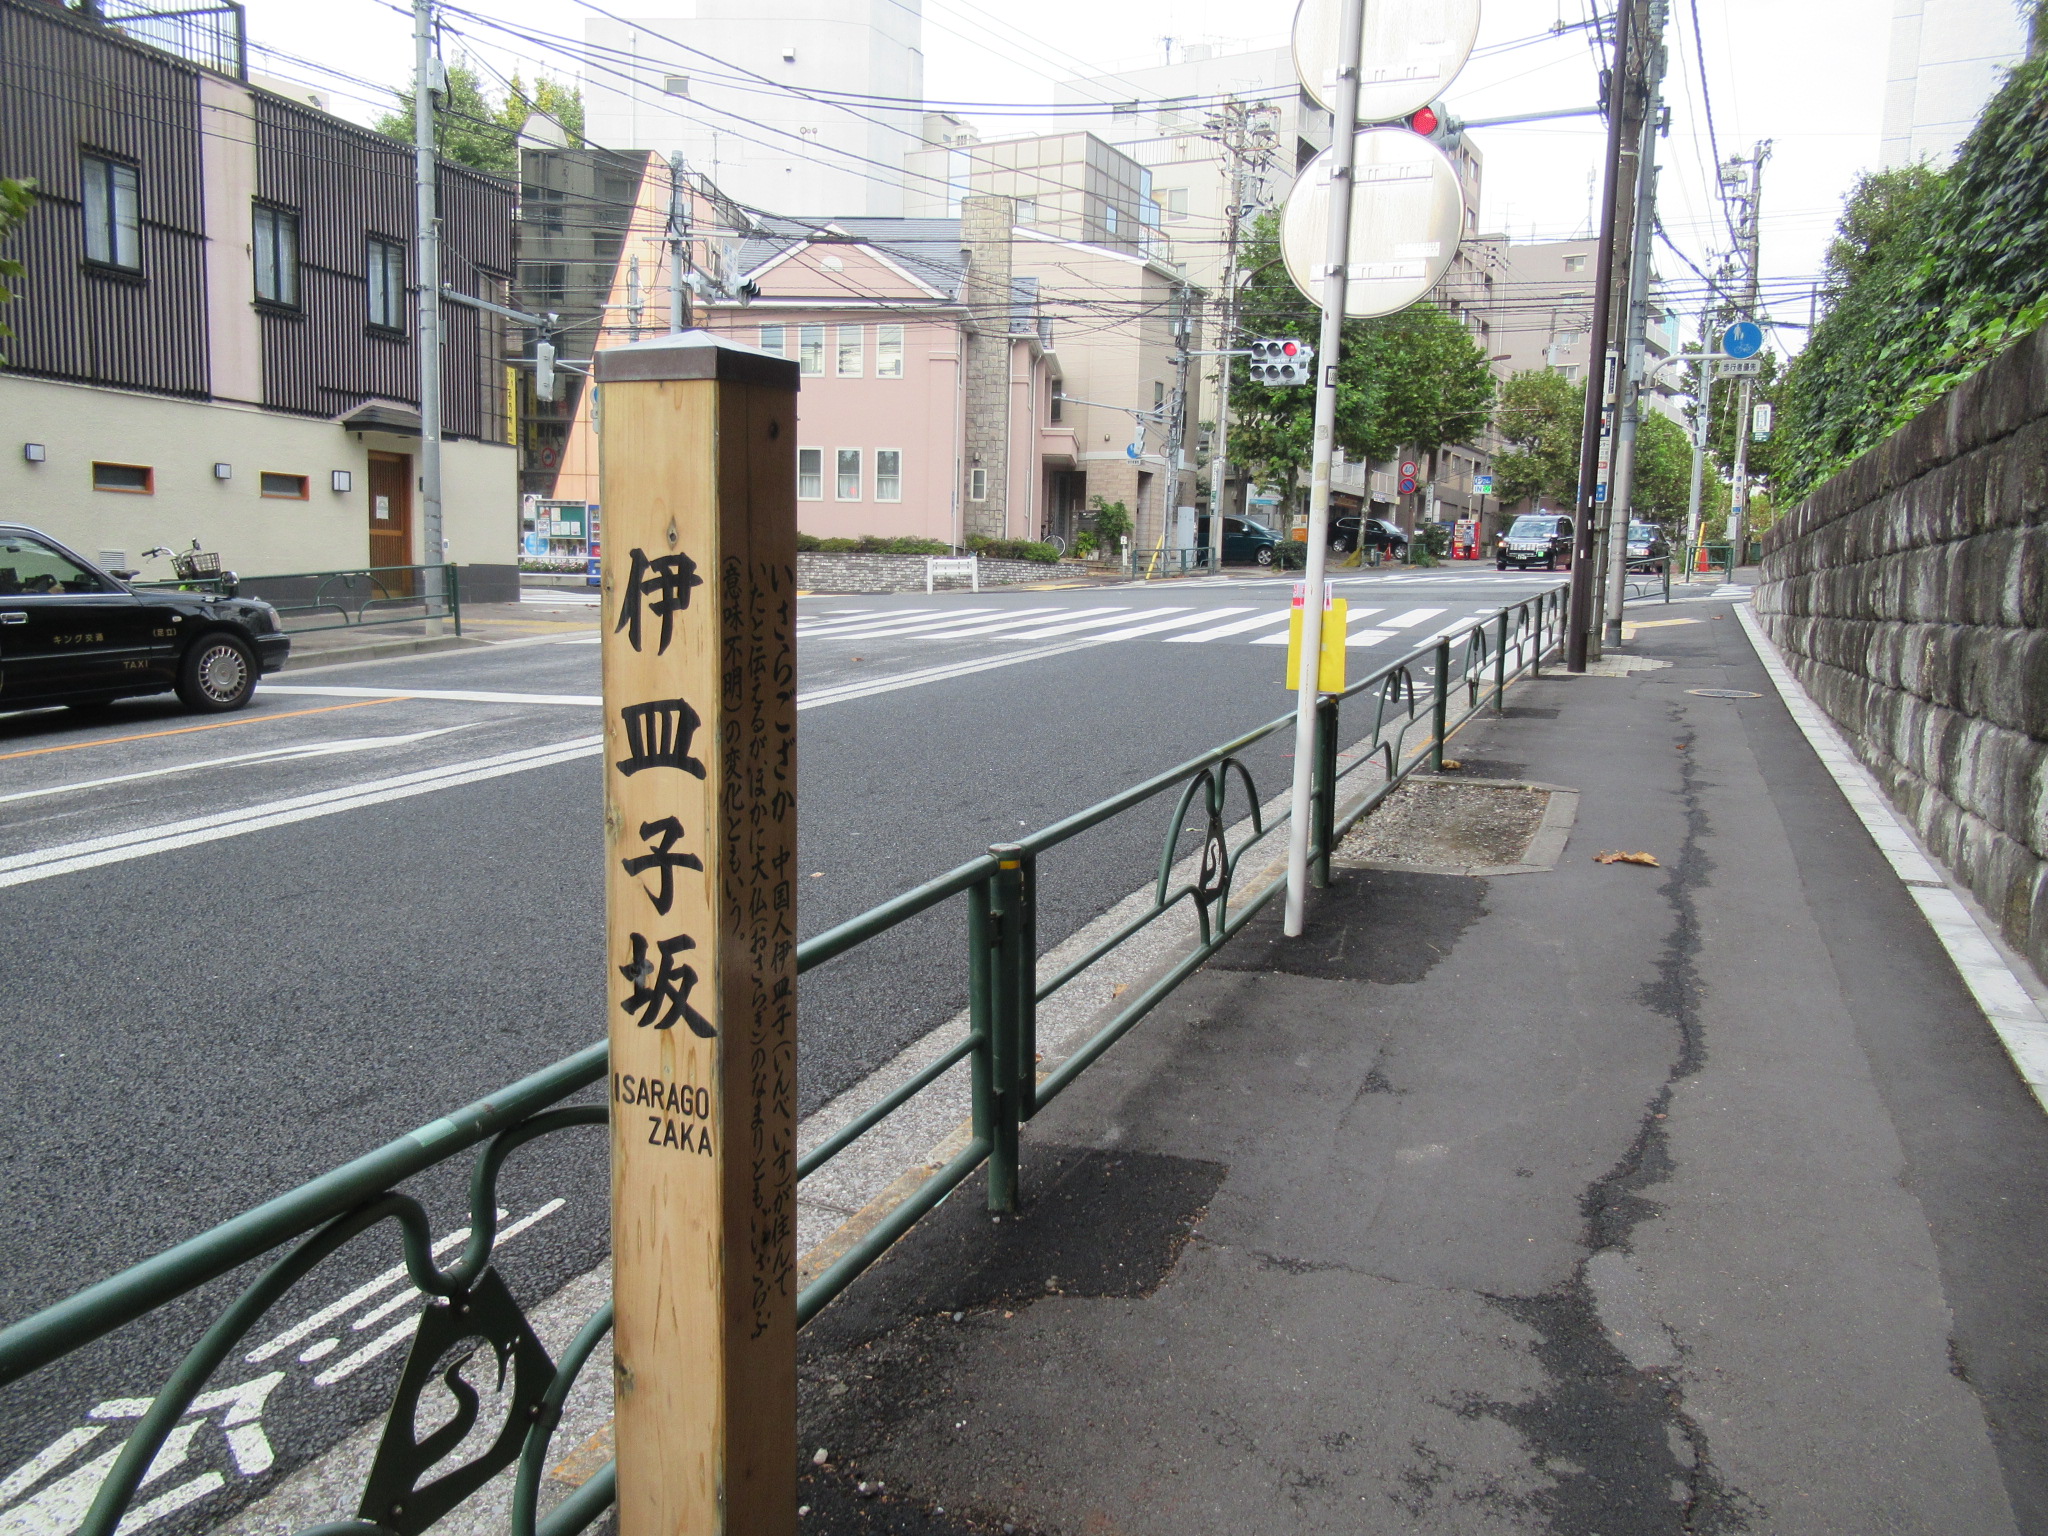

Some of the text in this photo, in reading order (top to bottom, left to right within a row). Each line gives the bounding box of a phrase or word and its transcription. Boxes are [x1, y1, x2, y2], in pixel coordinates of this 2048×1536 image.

[1404, 465, 1413, 473] 40
[123, 660, 148, 669] TAXI
[770, 563, 795, 824] いさらござか
[614, 547, 717, 1039] 伊皿子坂
[614, 1072, 710, 1120] ISARAGO
[648, 1116, 713, 1157] ZAKA
